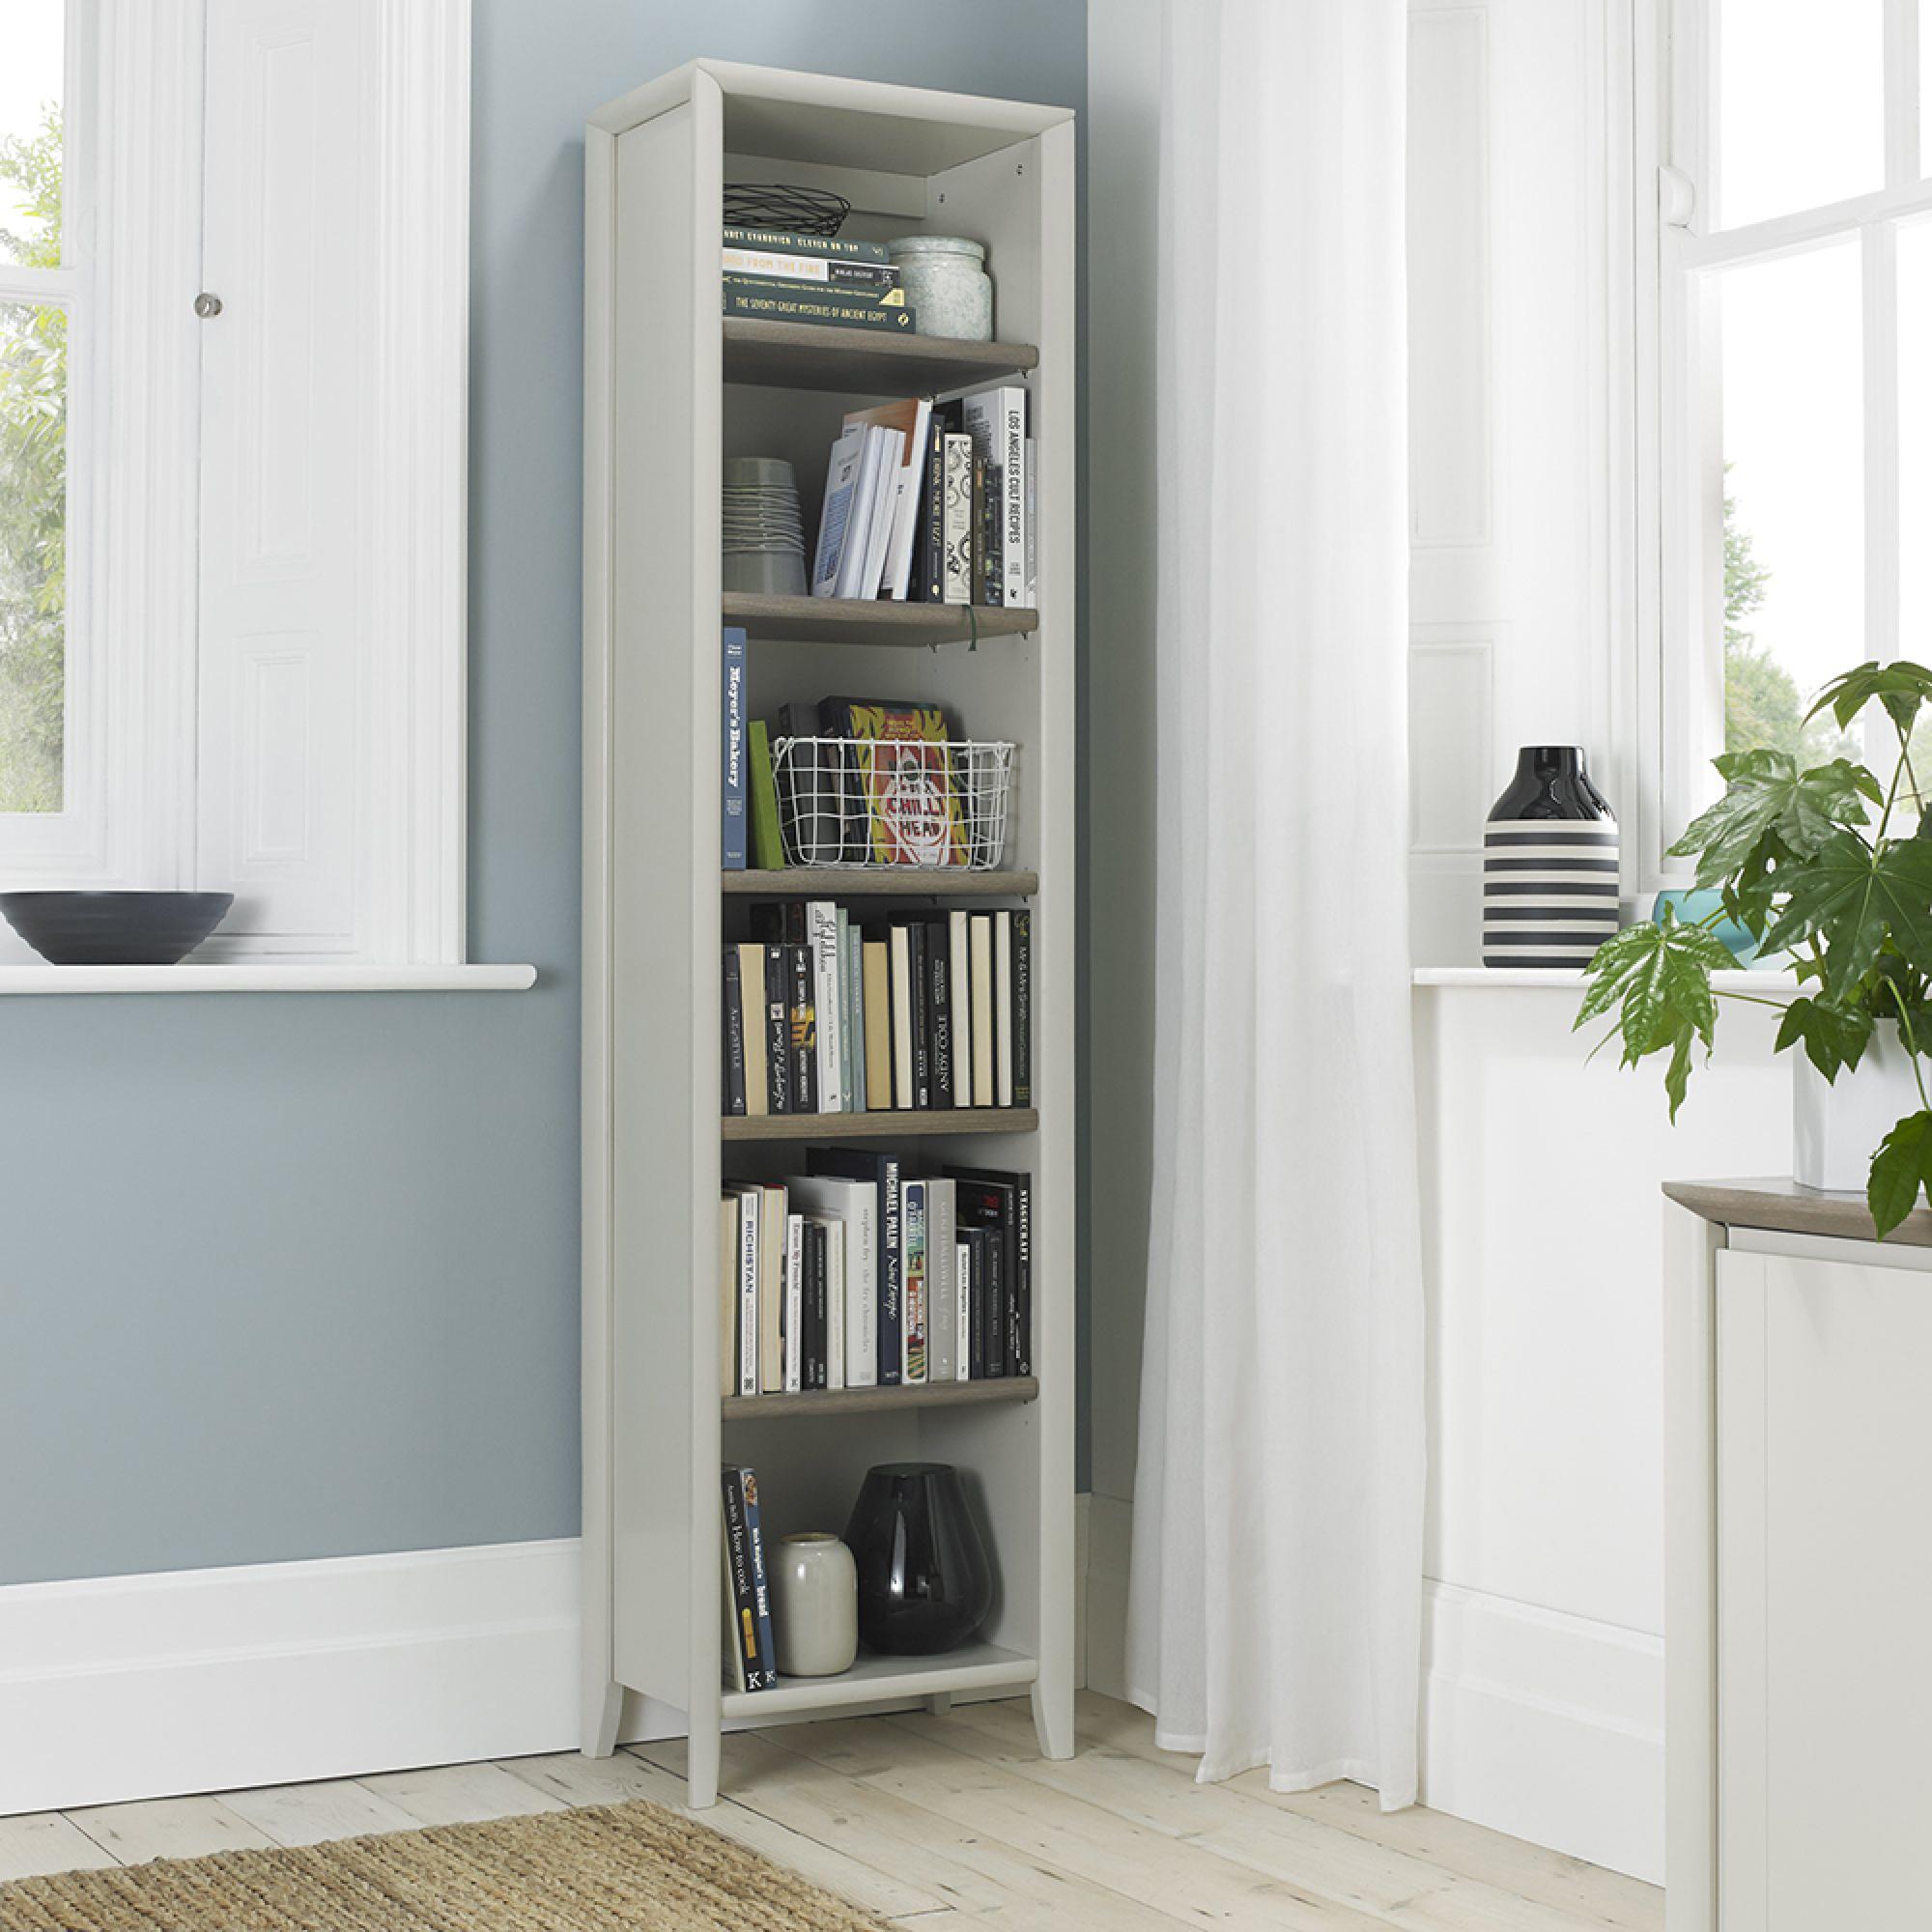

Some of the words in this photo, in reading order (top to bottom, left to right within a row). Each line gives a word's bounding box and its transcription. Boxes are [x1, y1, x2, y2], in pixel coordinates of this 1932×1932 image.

[746, 257, 774, 268] FROM
[778, 260, 795, 270] THE
[799, 263, 820, 274] FIRE
[735, 298, 749, 309] THE
[750, 299, 777, 312] SEVENTY
[778, 301, 798, 314] GREAT
[799, 305, 831, 317] MYSTERIES
[832, 307, 840, 318] OF
[841, 308, 867, 321] ANCIENT
[867, 311, 888, 323] EGYPT
[1009, 410, 1021, 430] LOS
[1009, 431, 1021, 476] ANGELES
[932, 491, 942, 516] MORE
[1009, 476, 1021, 501] CULT
[1009, 501, 1021, 544] RECIPES
[728, 666, 741, 726] Meyer's
[728, 728, 741, 787] Bakery
[899, 821, 941, 838] HEAD
[1019, 993, 1028, 1020] Smith
[937, 1013, 948, 1051] COLE
[938, 1052, 949, 1094] ANDY
[886, 1162, 898, 1214] MICHAEL
[861, 1208, 870, 1246] stephen
[886, 1215, 898, 1249] PALIN
[1020, 1189, 1029, 1262] STAGECRAFT
[745, 1219, 754, 1294] RICHISTAN
[731, 1525, 743, 1552] How
[736, 1553, 744, 1567] to
[737, 1567, 751, 1596] cook
[756, 1585, 769, 1617] bread
